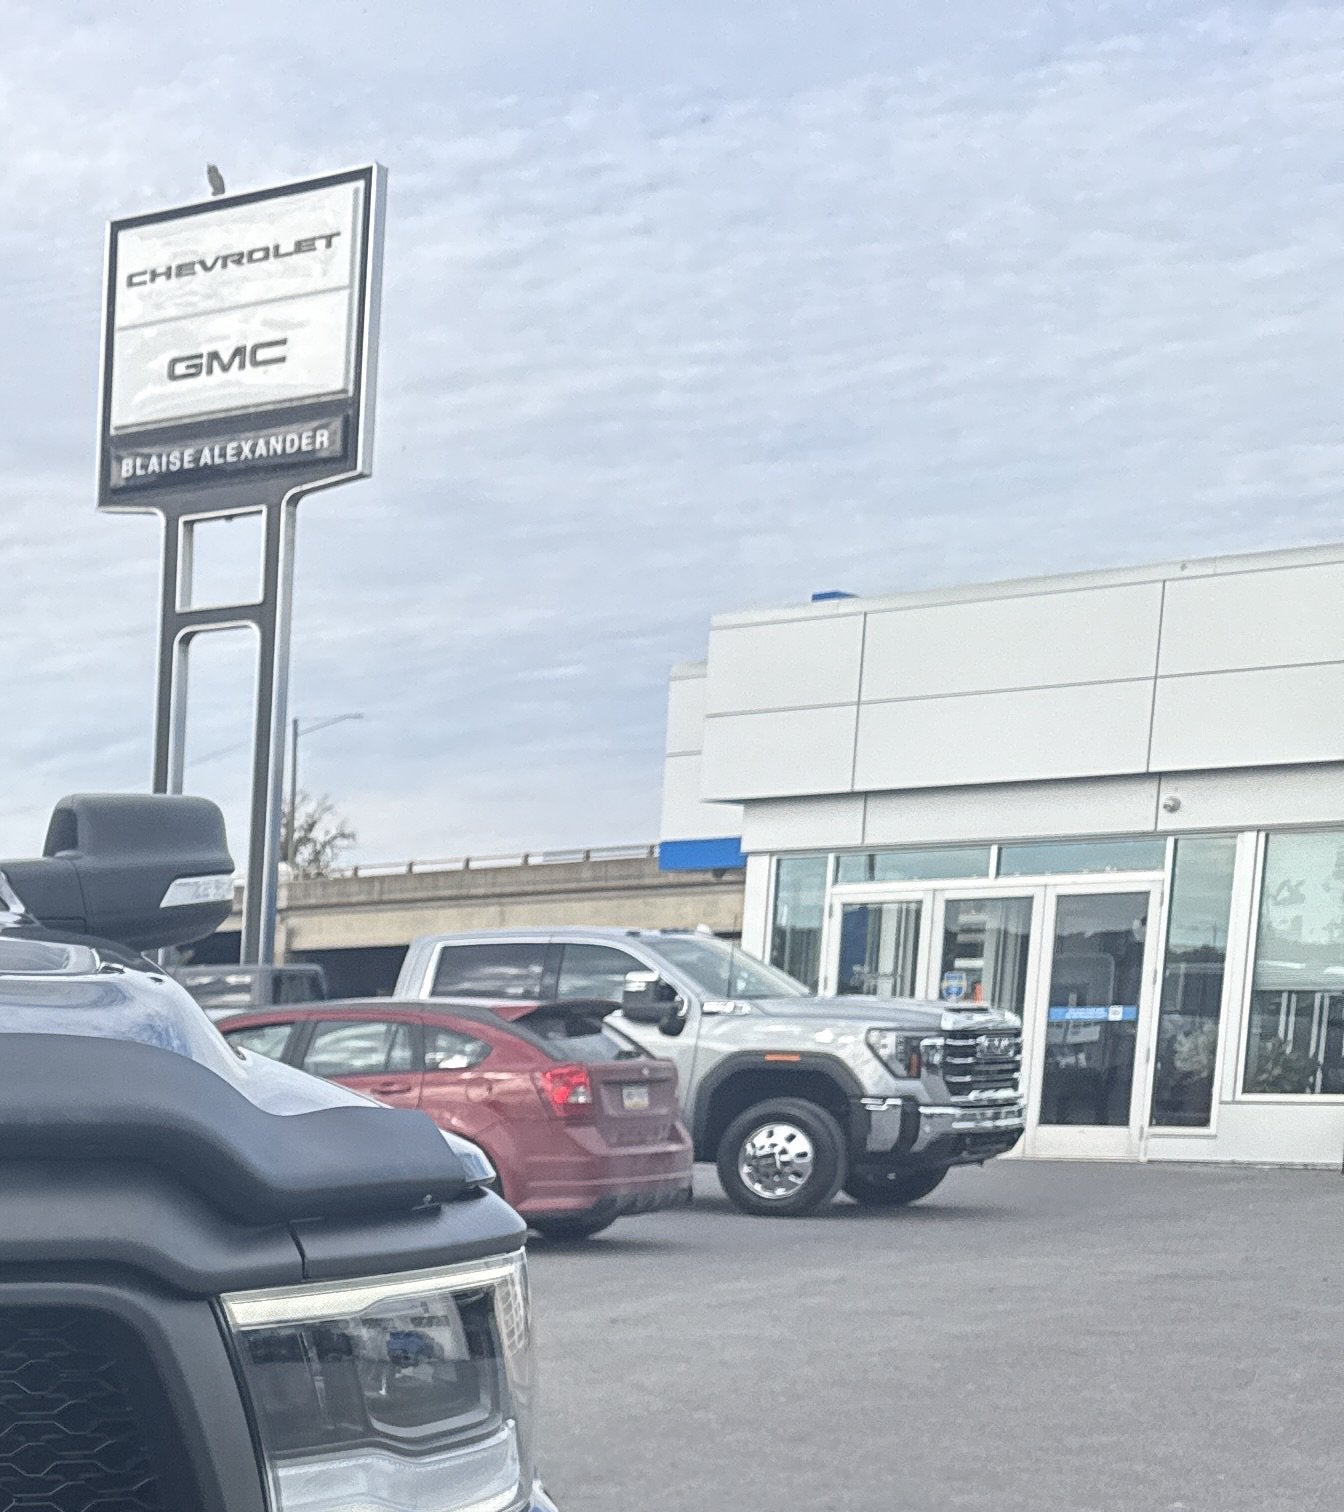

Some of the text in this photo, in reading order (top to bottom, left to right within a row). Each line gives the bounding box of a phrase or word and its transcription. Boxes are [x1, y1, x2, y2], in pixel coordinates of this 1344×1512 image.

[126, 231, 341, 288] CHEVROLET
[166, 337, 288, 382] GMC
[120, 428, 330, 479] BLAISE ALEXANDER
